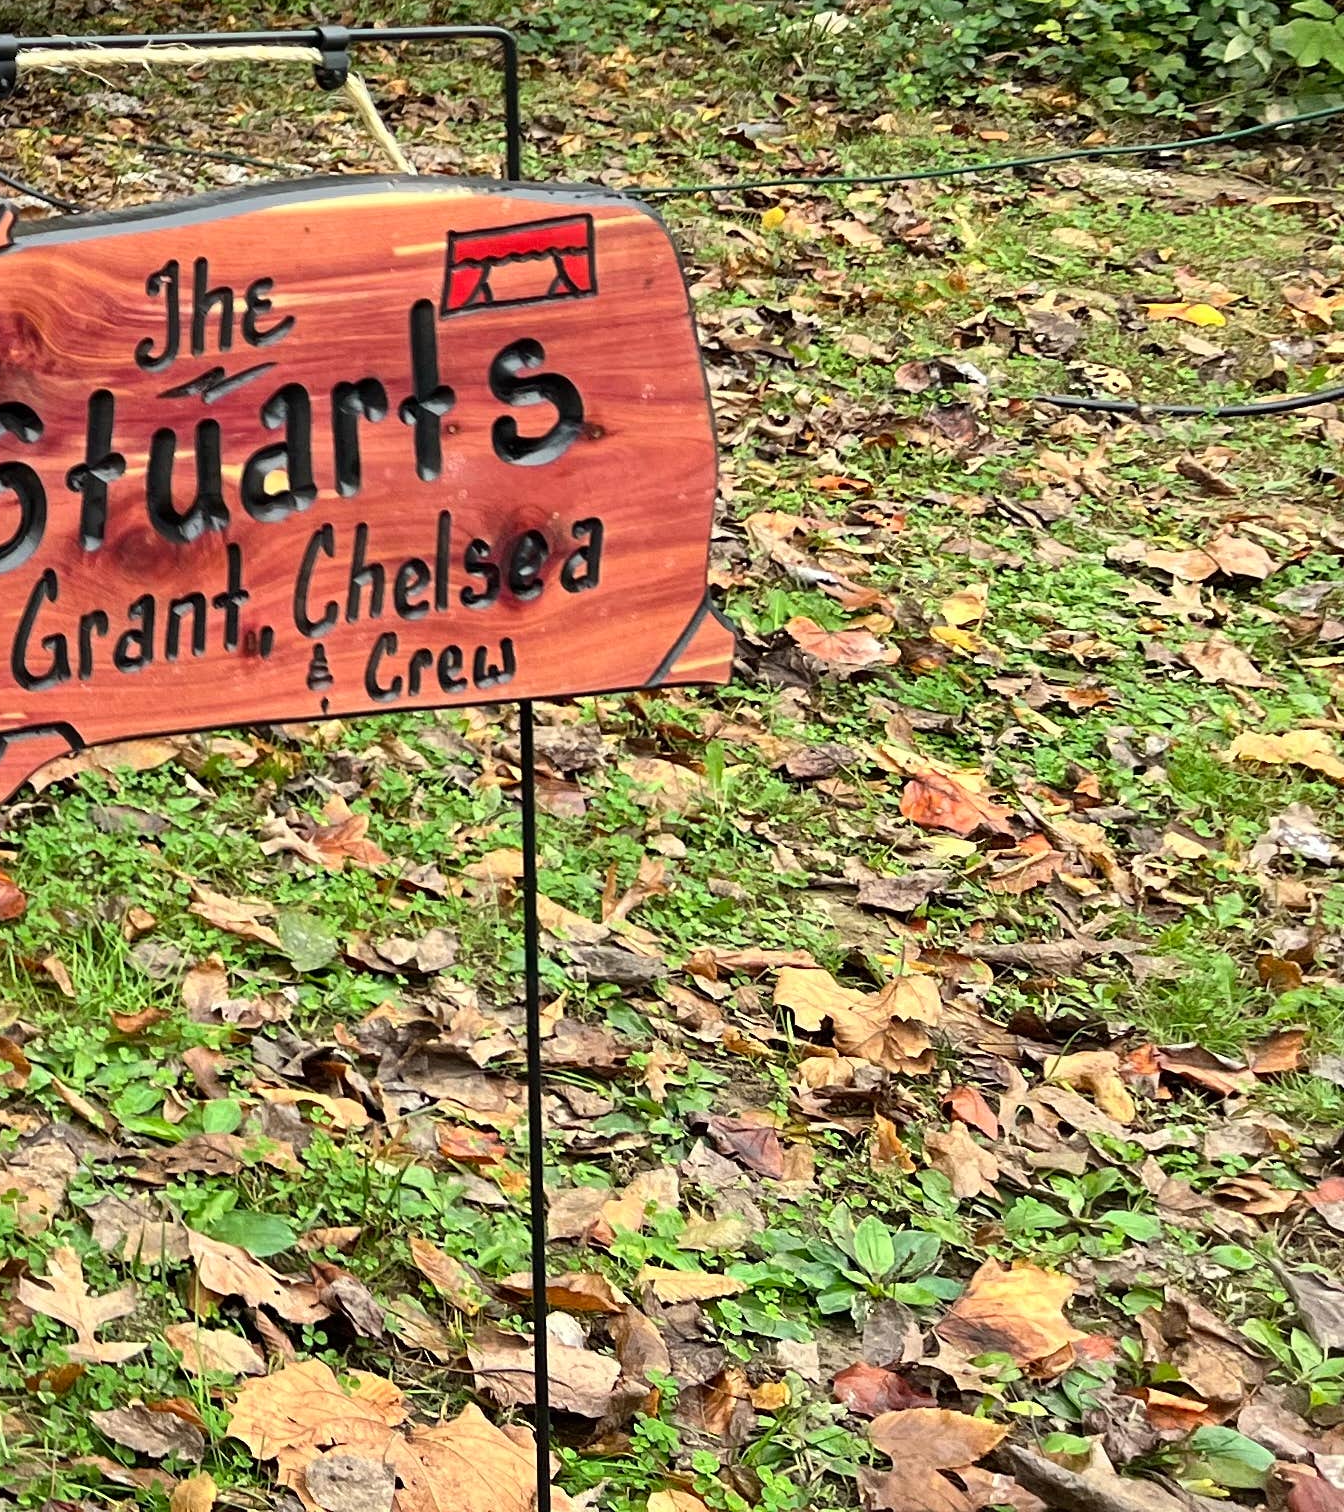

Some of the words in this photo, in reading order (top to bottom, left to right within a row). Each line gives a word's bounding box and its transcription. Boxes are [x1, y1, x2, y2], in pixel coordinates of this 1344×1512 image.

[134, 255, 298, 373] The
[292, 509, 606, 639] Chelsea
[364, 630, 518, 704] Crew
